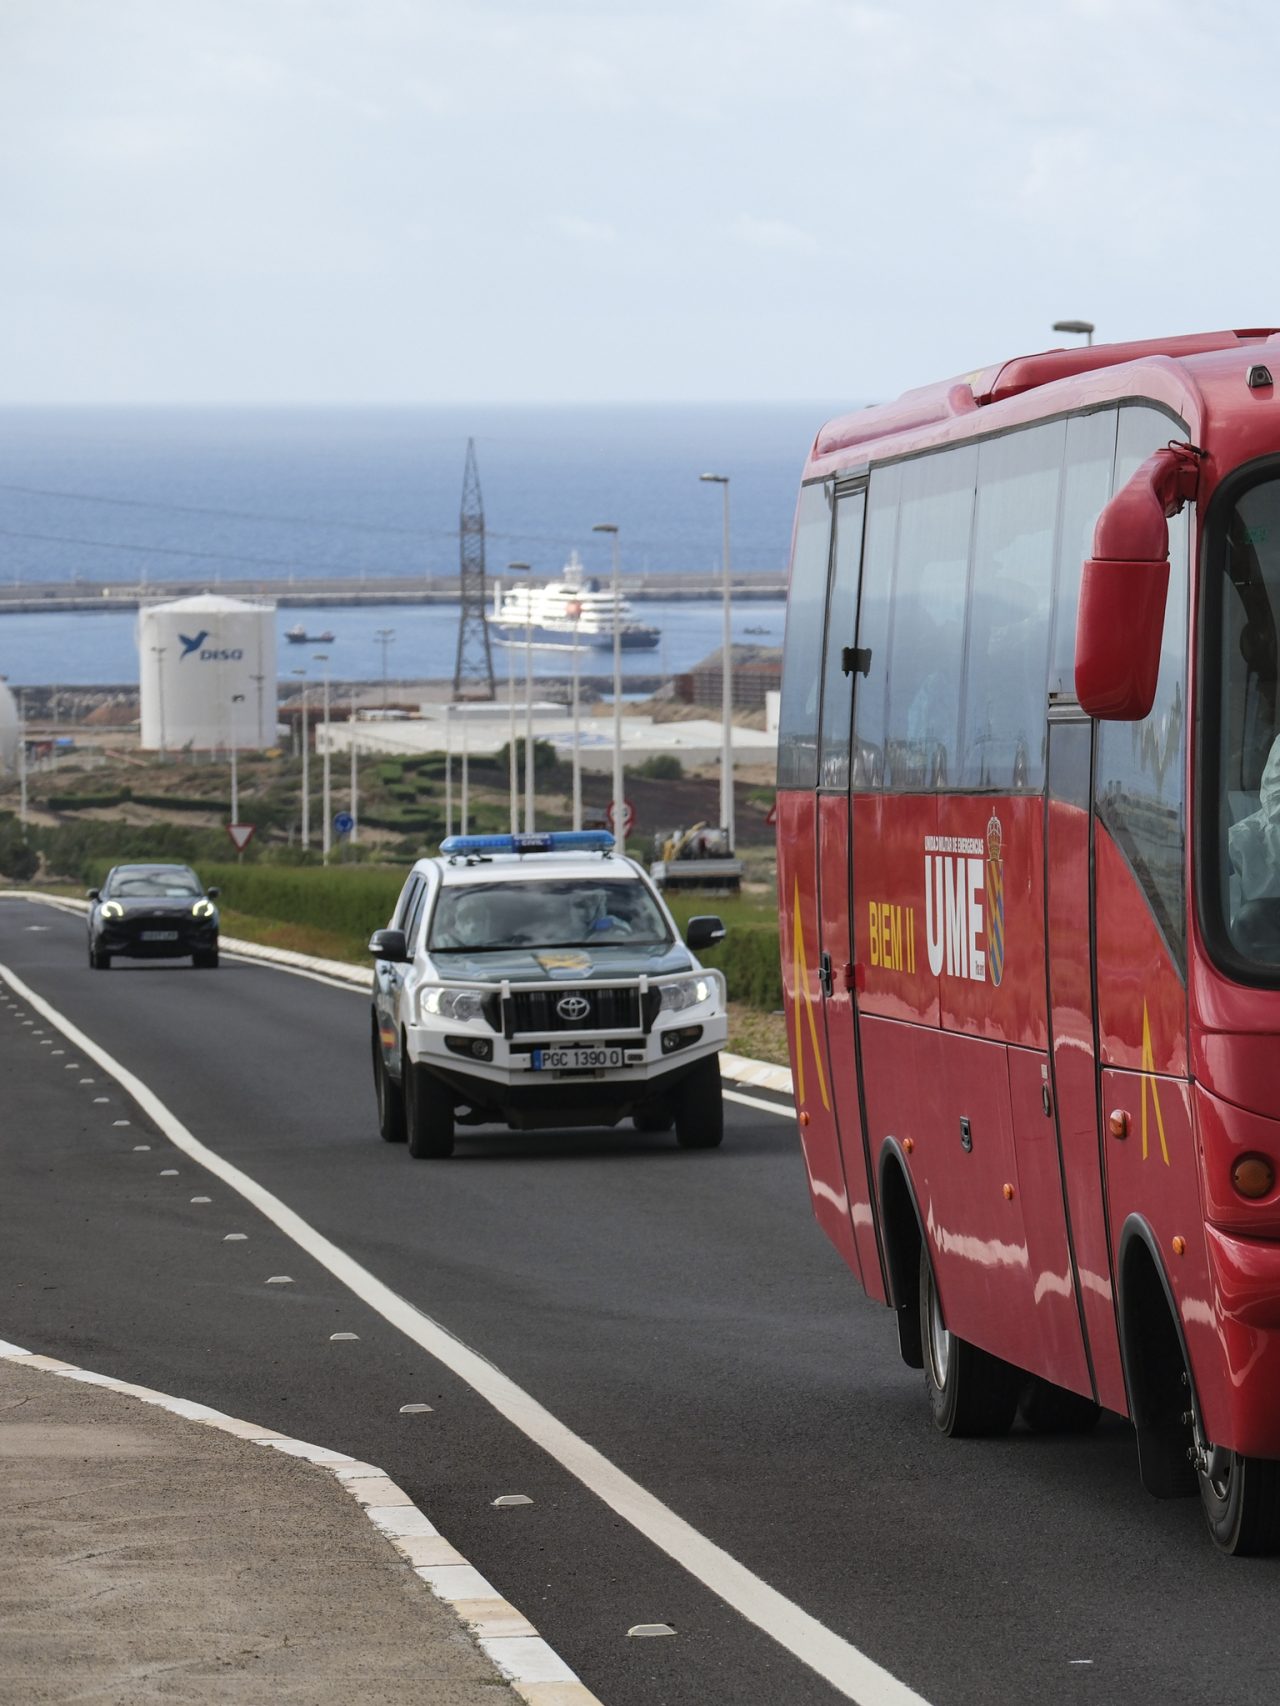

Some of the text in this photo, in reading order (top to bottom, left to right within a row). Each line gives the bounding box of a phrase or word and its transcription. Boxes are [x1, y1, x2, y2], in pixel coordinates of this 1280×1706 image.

[869, 901, 915, 974] BIEM II
[925, 856, 985, 982] UME
[542, 1052, 568, 1067] PGC
[574, 1050, 606, 1066] 1390
